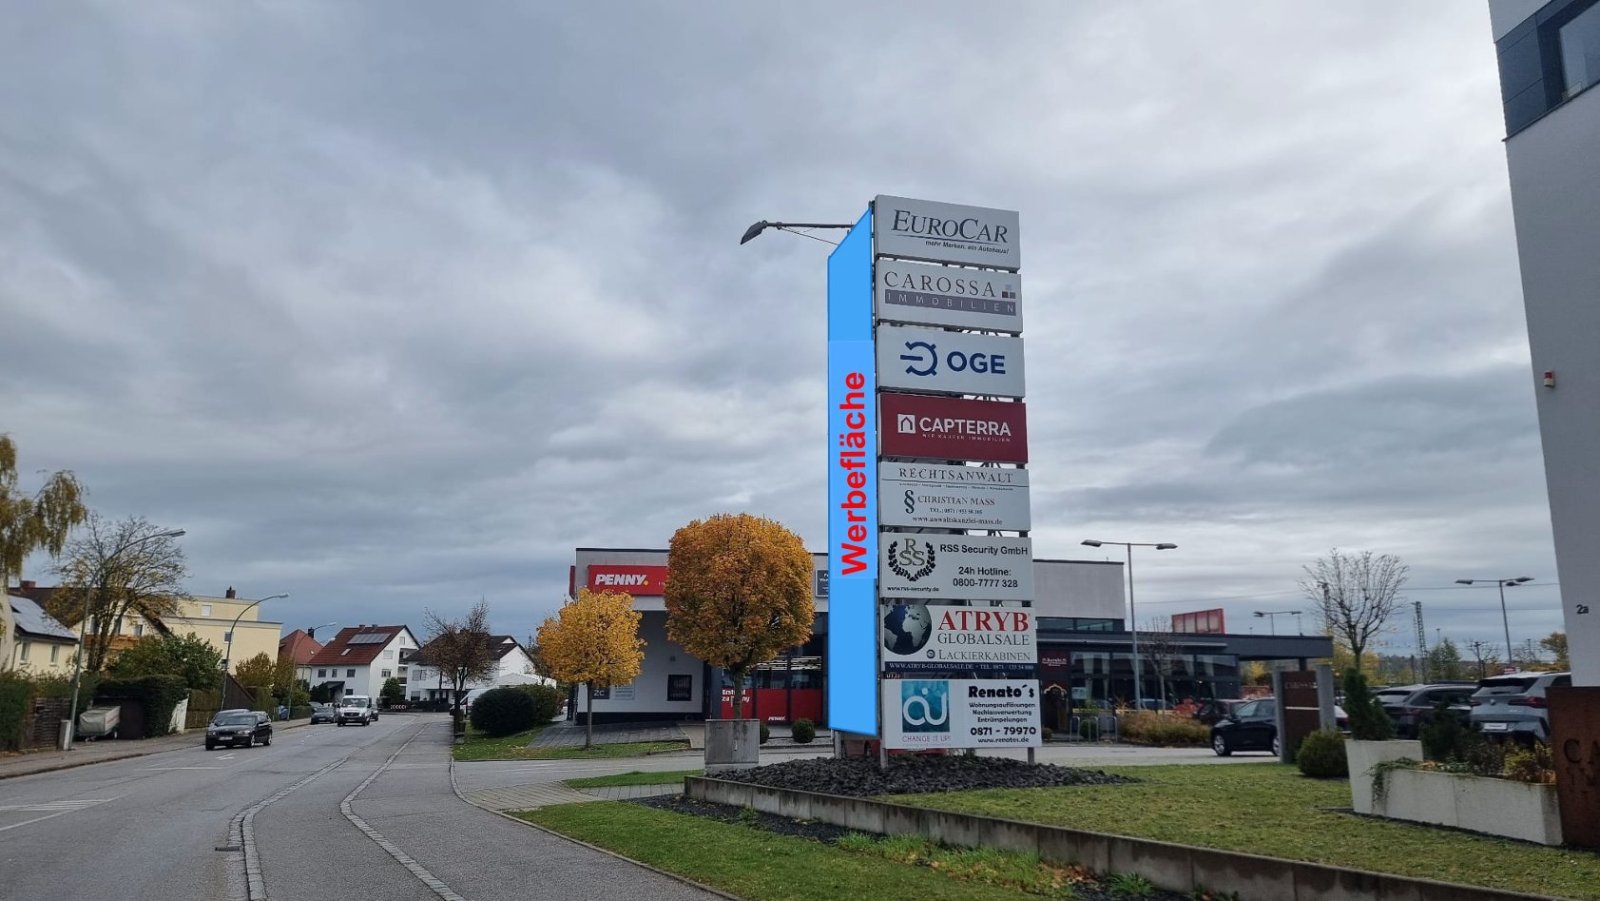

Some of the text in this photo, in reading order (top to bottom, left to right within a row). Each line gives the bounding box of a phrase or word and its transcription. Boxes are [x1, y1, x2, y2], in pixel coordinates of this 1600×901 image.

[884, 271, 996, 297] CAROSSA
[887, 292, 1014, 313] IMMOBILIEN
[947, 350, 1006, 375] OGE
[919, 417, 1012, 436] CAPTERRA
[899, 468, 1014, 483] RECHTSANWALT
[917, 495, 996, 506] CHRISTIAN MASS
[939, 544, 1028, 556] RSS Security GmbH
[958, 566, 1012, 576] 24h Hotline:
[952, 578, 1018, 588] 0800-7777 328
[1576, 604, 1589, 615] 2a
[937, 610, 1030, 632] ATRYB
[937, 633, 1030, 646] GLOBALSALE
[938, 649, 1031, 661] LACKIERKABINEN
[977, 716, 1027, 724] Entrümpelungen
[970, 726, 992, 736] 0871
[1003, 726, 1037, 736] 79970
[902, 735, 930, 743] CHANGE
